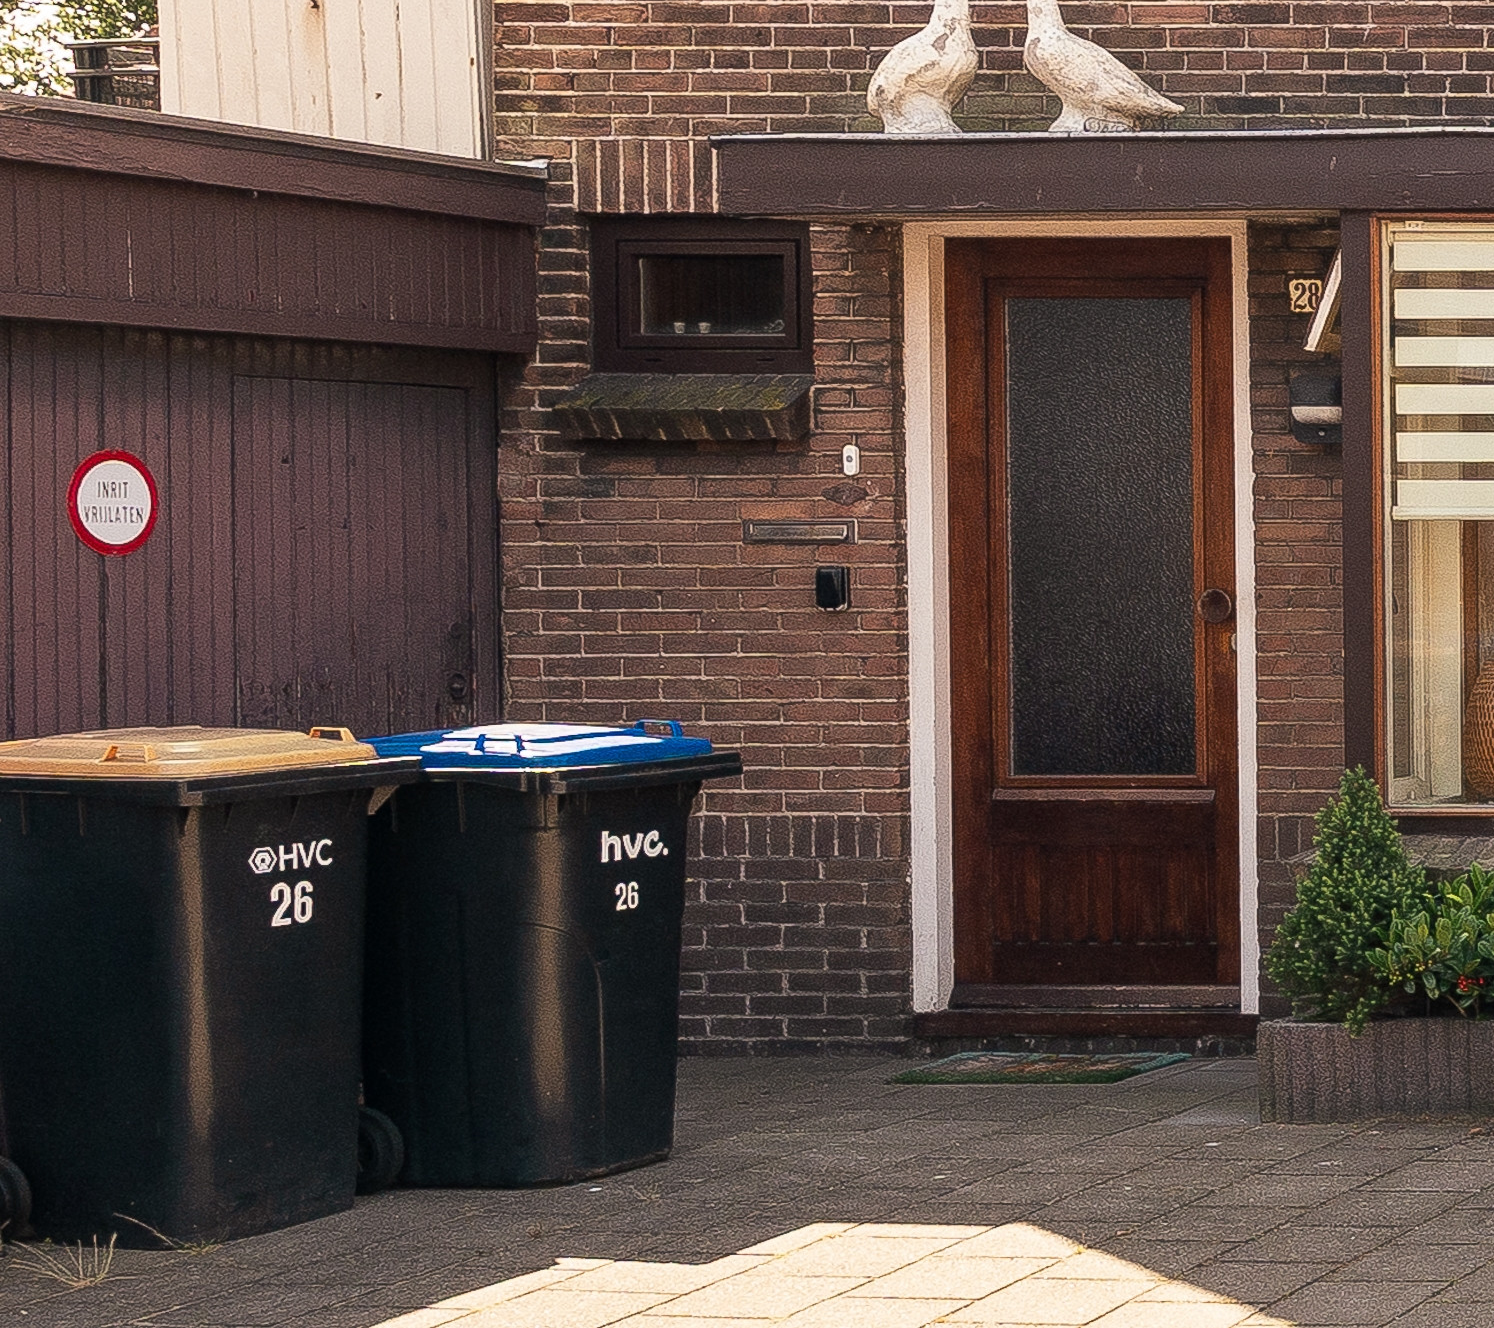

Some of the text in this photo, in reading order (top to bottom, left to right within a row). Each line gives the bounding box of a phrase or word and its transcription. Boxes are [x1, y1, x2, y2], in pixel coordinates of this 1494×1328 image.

[1293, 282, 1320, 310] 28
[97, 481, 129, 499] INRIT
[84, 505, 144, 524] VRIJLATEN
[278, 838, 333, 872] HVC
[601, 830, 669, 863] hvc.
[270, 880, 314, 927] 26
[615, 881, 639, 911] 26
